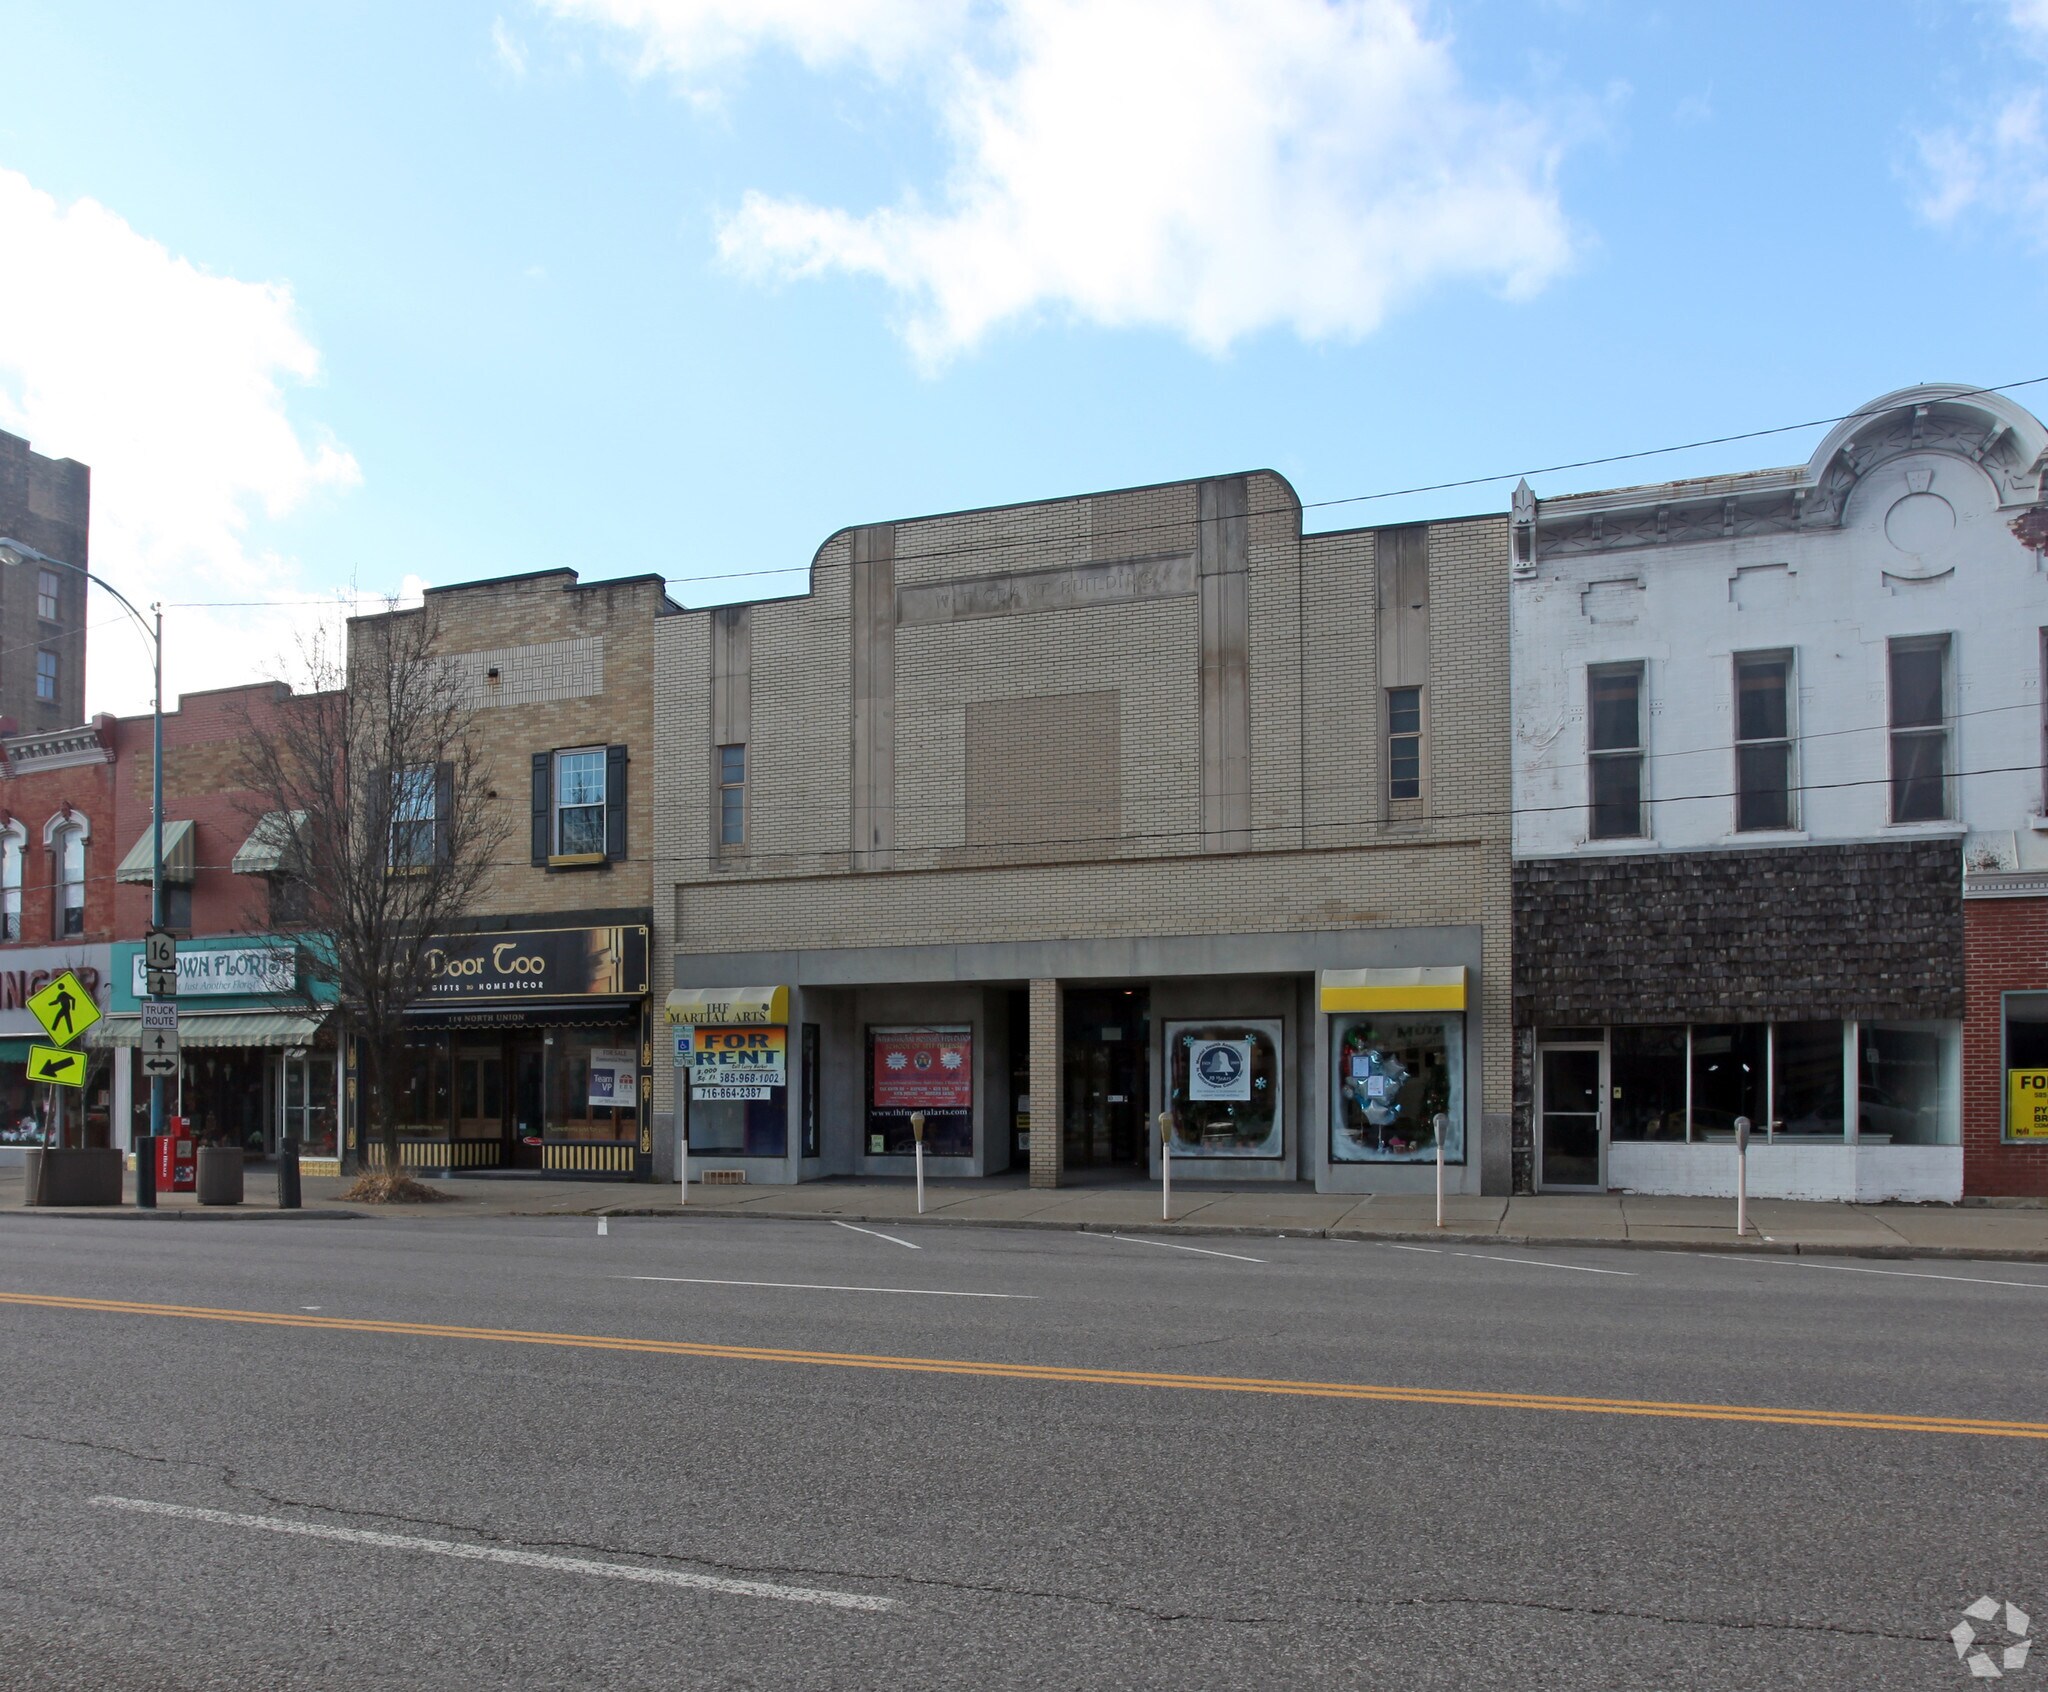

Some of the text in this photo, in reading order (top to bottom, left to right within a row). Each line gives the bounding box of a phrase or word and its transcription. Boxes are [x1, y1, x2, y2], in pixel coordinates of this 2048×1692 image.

[1061, 571, 1153, 595] BUILDING
[152, 941, 170, 961] 16
[424, 948, 485, 978] Door
[493, 943, 545, 975] Too
[138, 956, 210, 979] UOWN
[184, 982, 198, 991] Just
[200, 981, 231, 991] Another
[432, 984, 460, 992] GIFTS
[145, 1005, 175, 1015] TRUCK
[145, 1016, 175, 1026] ROUTE
[464, 1014, 493, 1022] NORTH
[496, 1013, 525, 1021] UNION
[670, 1011, 767, 1023] MARTIAL ARTS
[705, 1033, 769, 1049] FOR
[696, 1050, 780, 1065] RENT
[594, 1074, 613, 1083] Team
[2021, 1076, 2048, 1089] FO
[602, 1083, 613, 1091] VP
